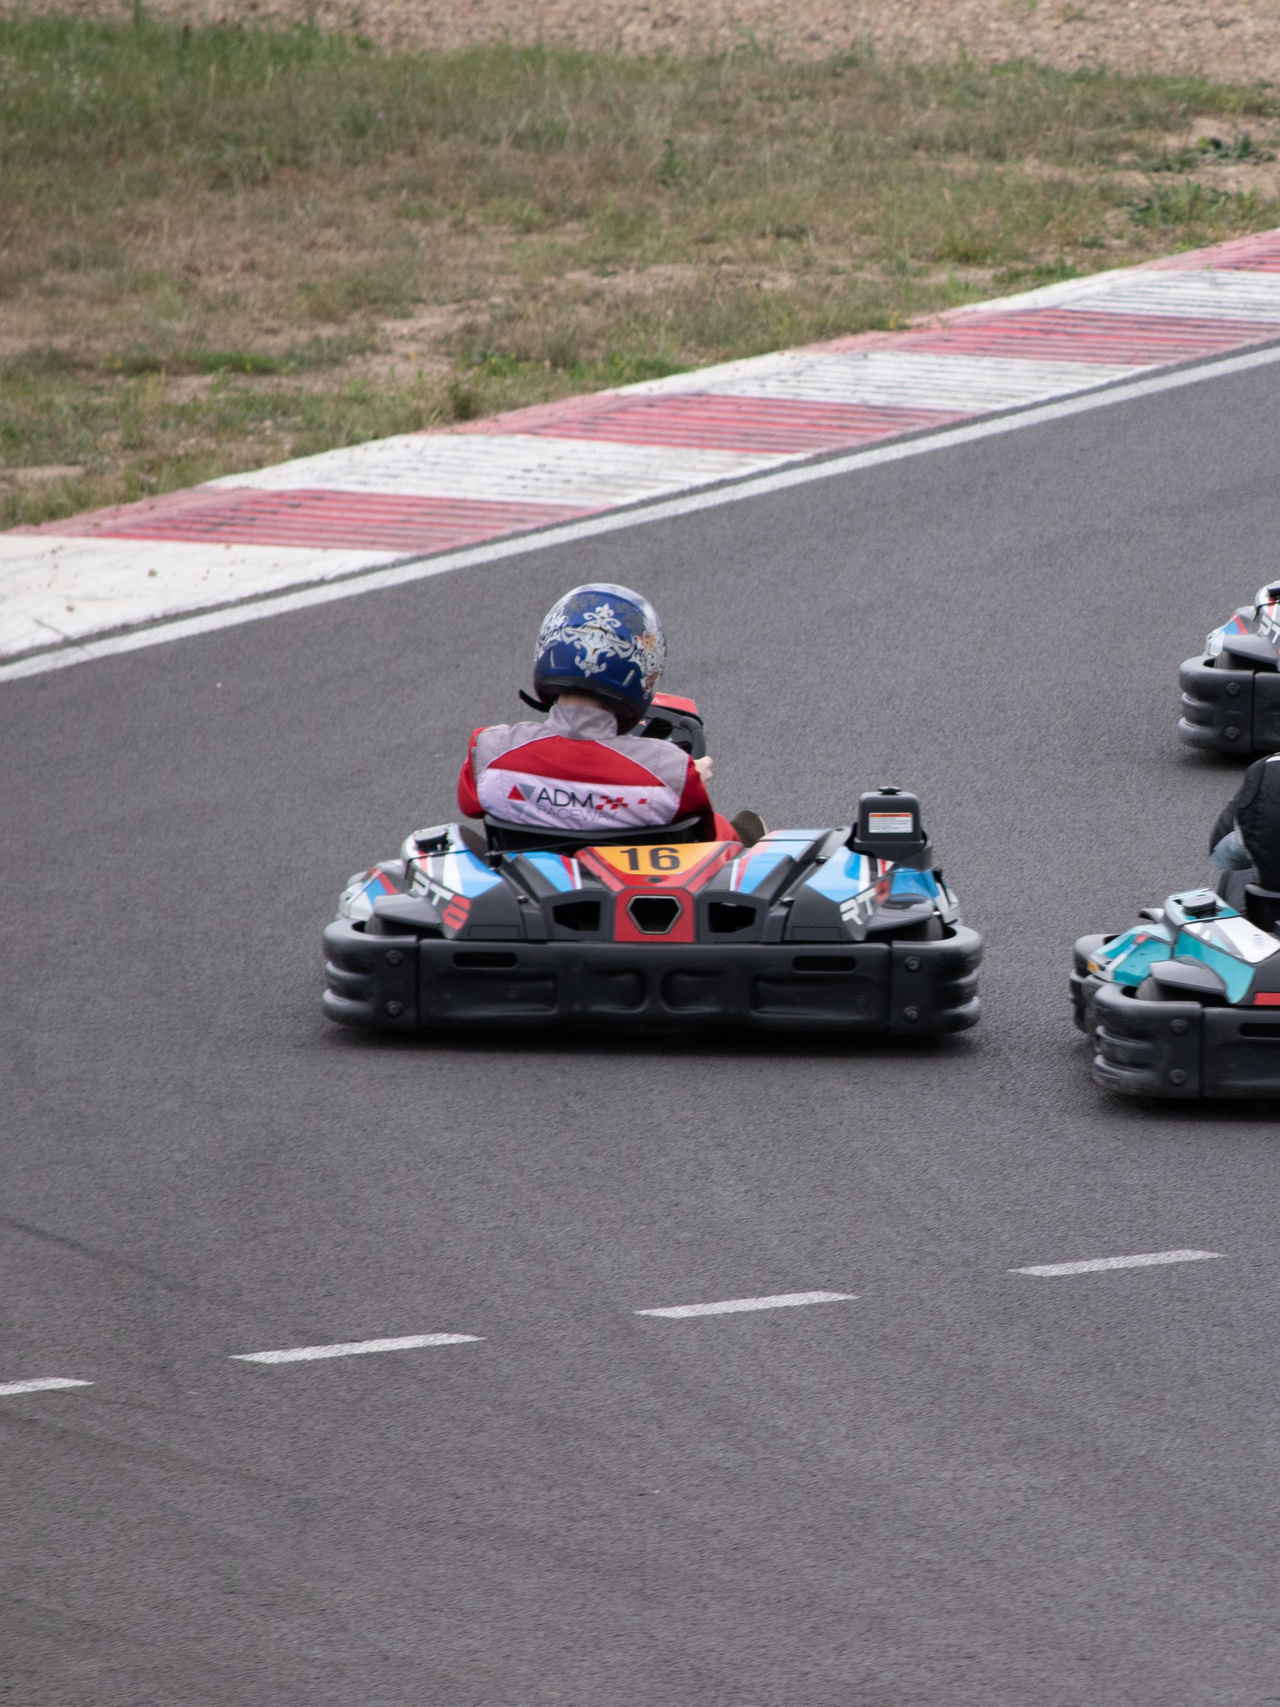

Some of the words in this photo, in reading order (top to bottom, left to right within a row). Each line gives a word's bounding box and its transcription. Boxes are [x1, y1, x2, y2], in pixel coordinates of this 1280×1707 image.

[536, 787, 595, 810] ADM
[536, 805, 618, 822] RACEWAY
[620, 847, 680, 871] 16
